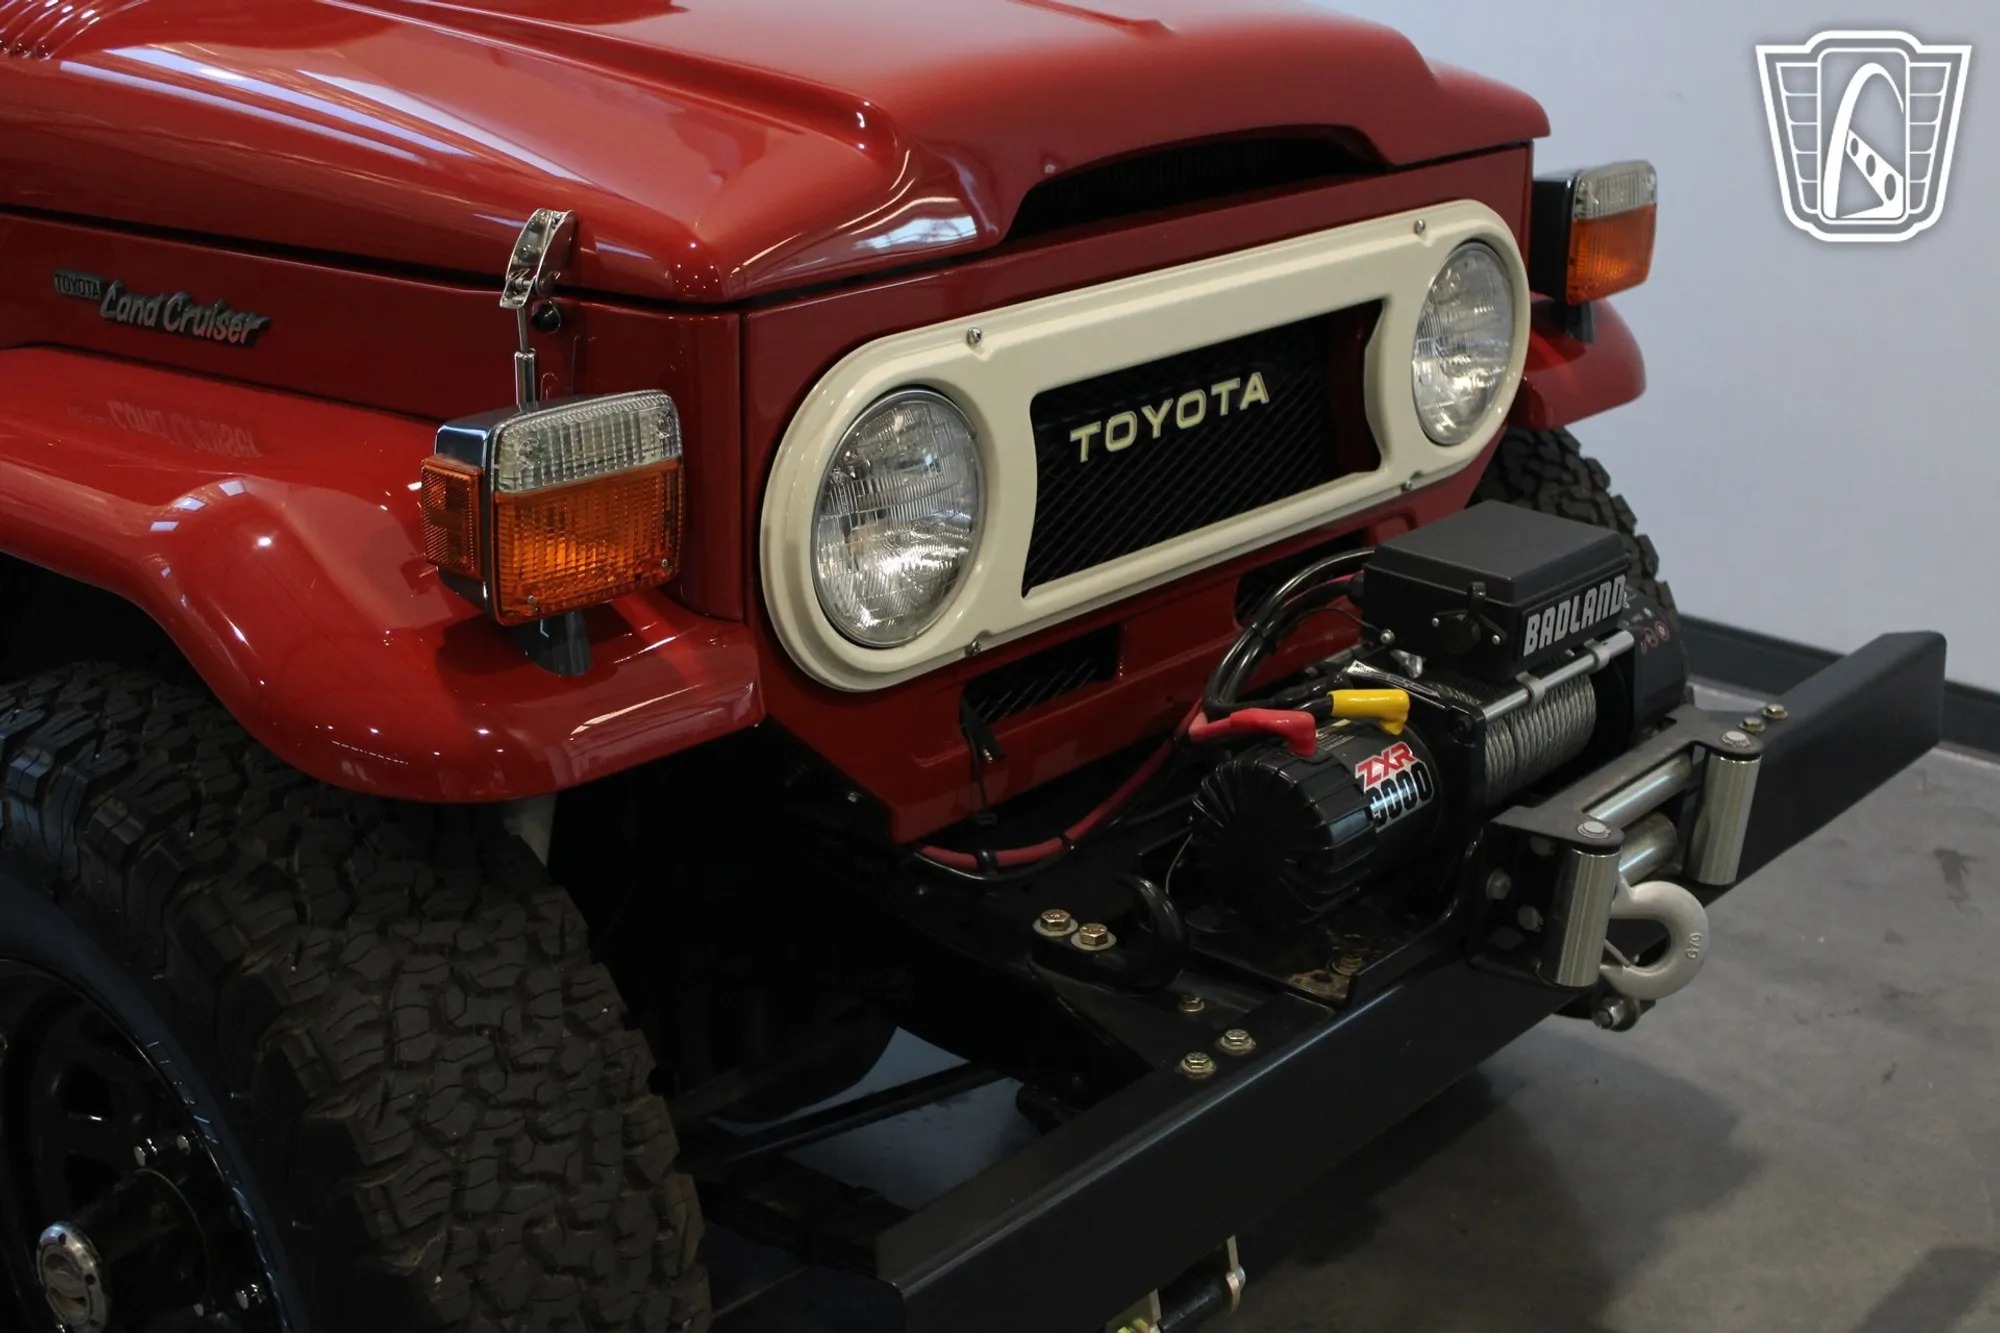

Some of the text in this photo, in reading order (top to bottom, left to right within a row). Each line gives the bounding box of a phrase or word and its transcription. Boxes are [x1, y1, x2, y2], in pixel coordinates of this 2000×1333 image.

[54, 273, 102, 298] TOYOTA
[101, 279, 269, 344] Land Cruiser
[1069, 371, 1270, 463] TOYOTA
[1522, 573, 1627, 657] BADLAND
[1356, 741, 1417, 790] ZXR
